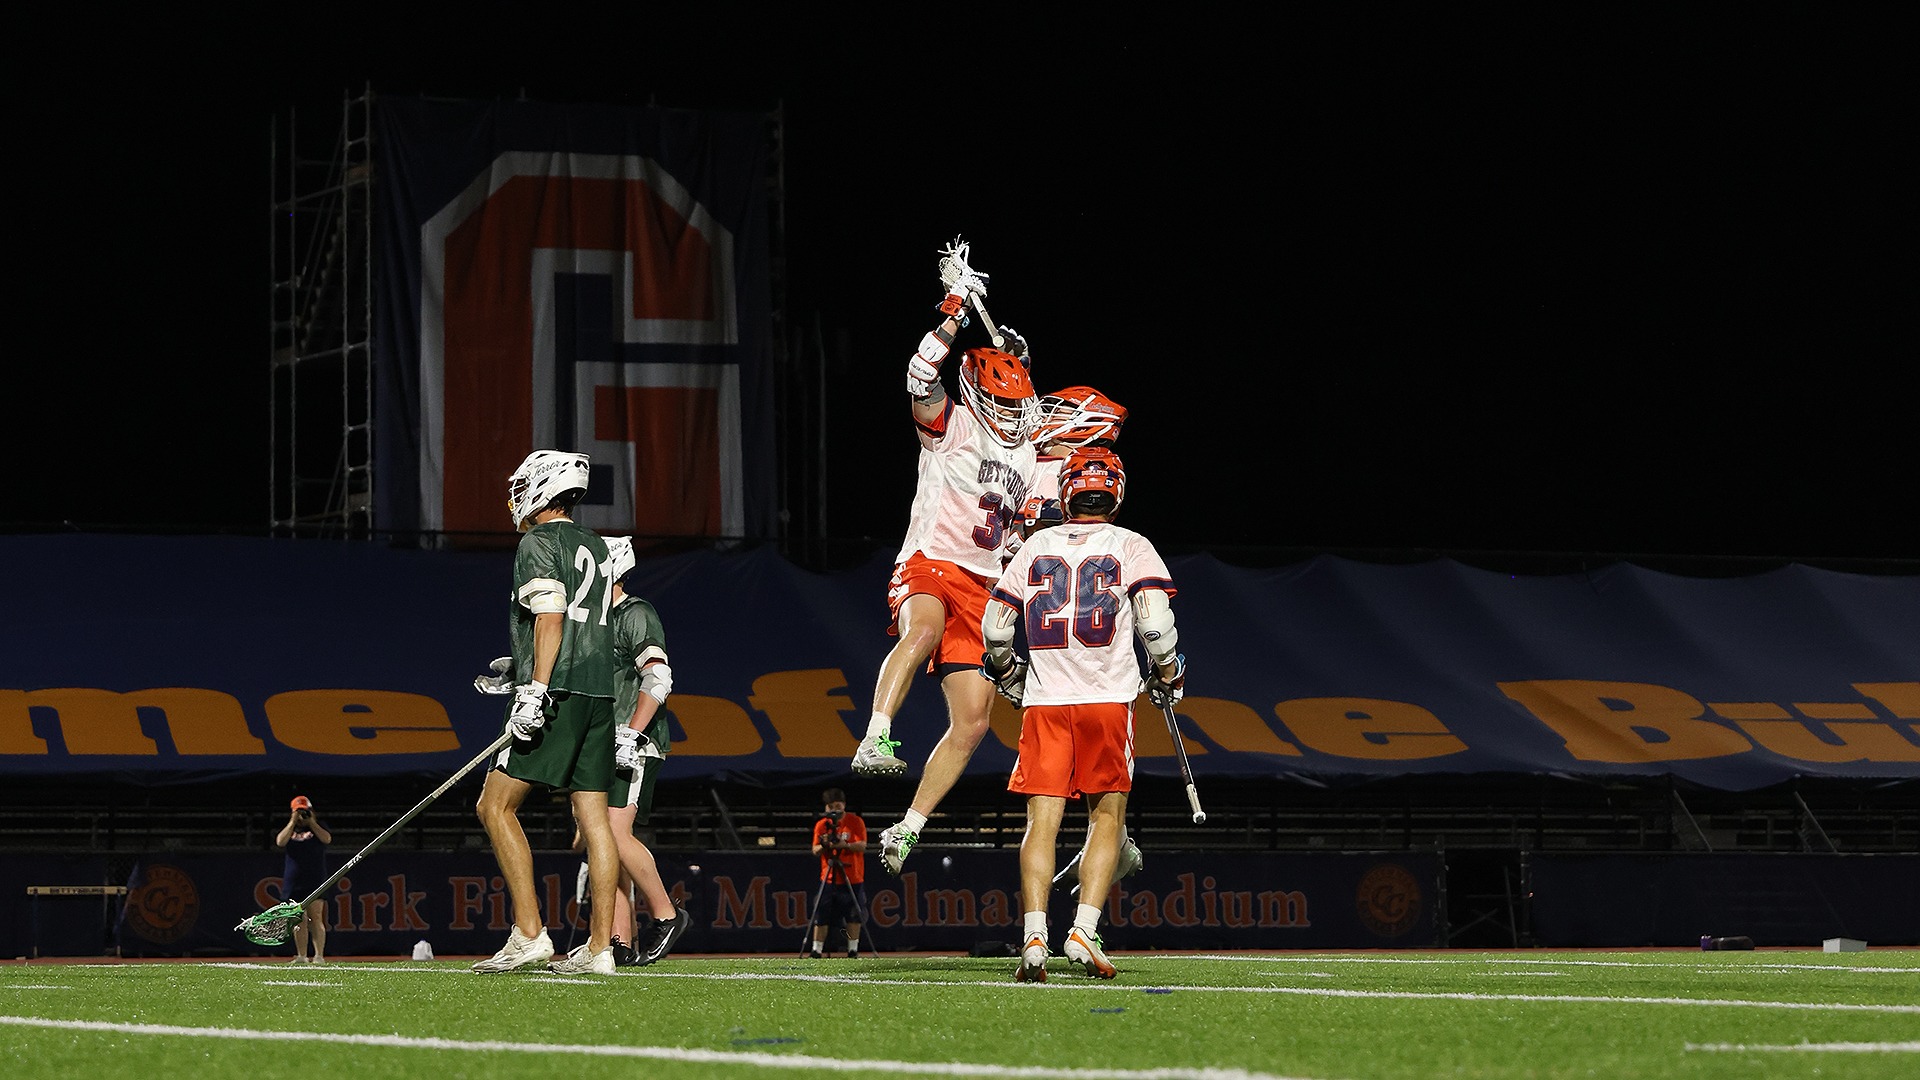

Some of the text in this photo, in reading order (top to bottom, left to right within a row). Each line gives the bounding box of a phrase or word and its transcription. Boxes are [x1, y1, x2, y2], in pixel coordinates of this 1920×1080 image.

[420, 151, 745, 550] G
[1026, 554, 1122, 650] 26
[988, 696, 1469, 760] he
[1074, 871, 1311, 929] tadium
